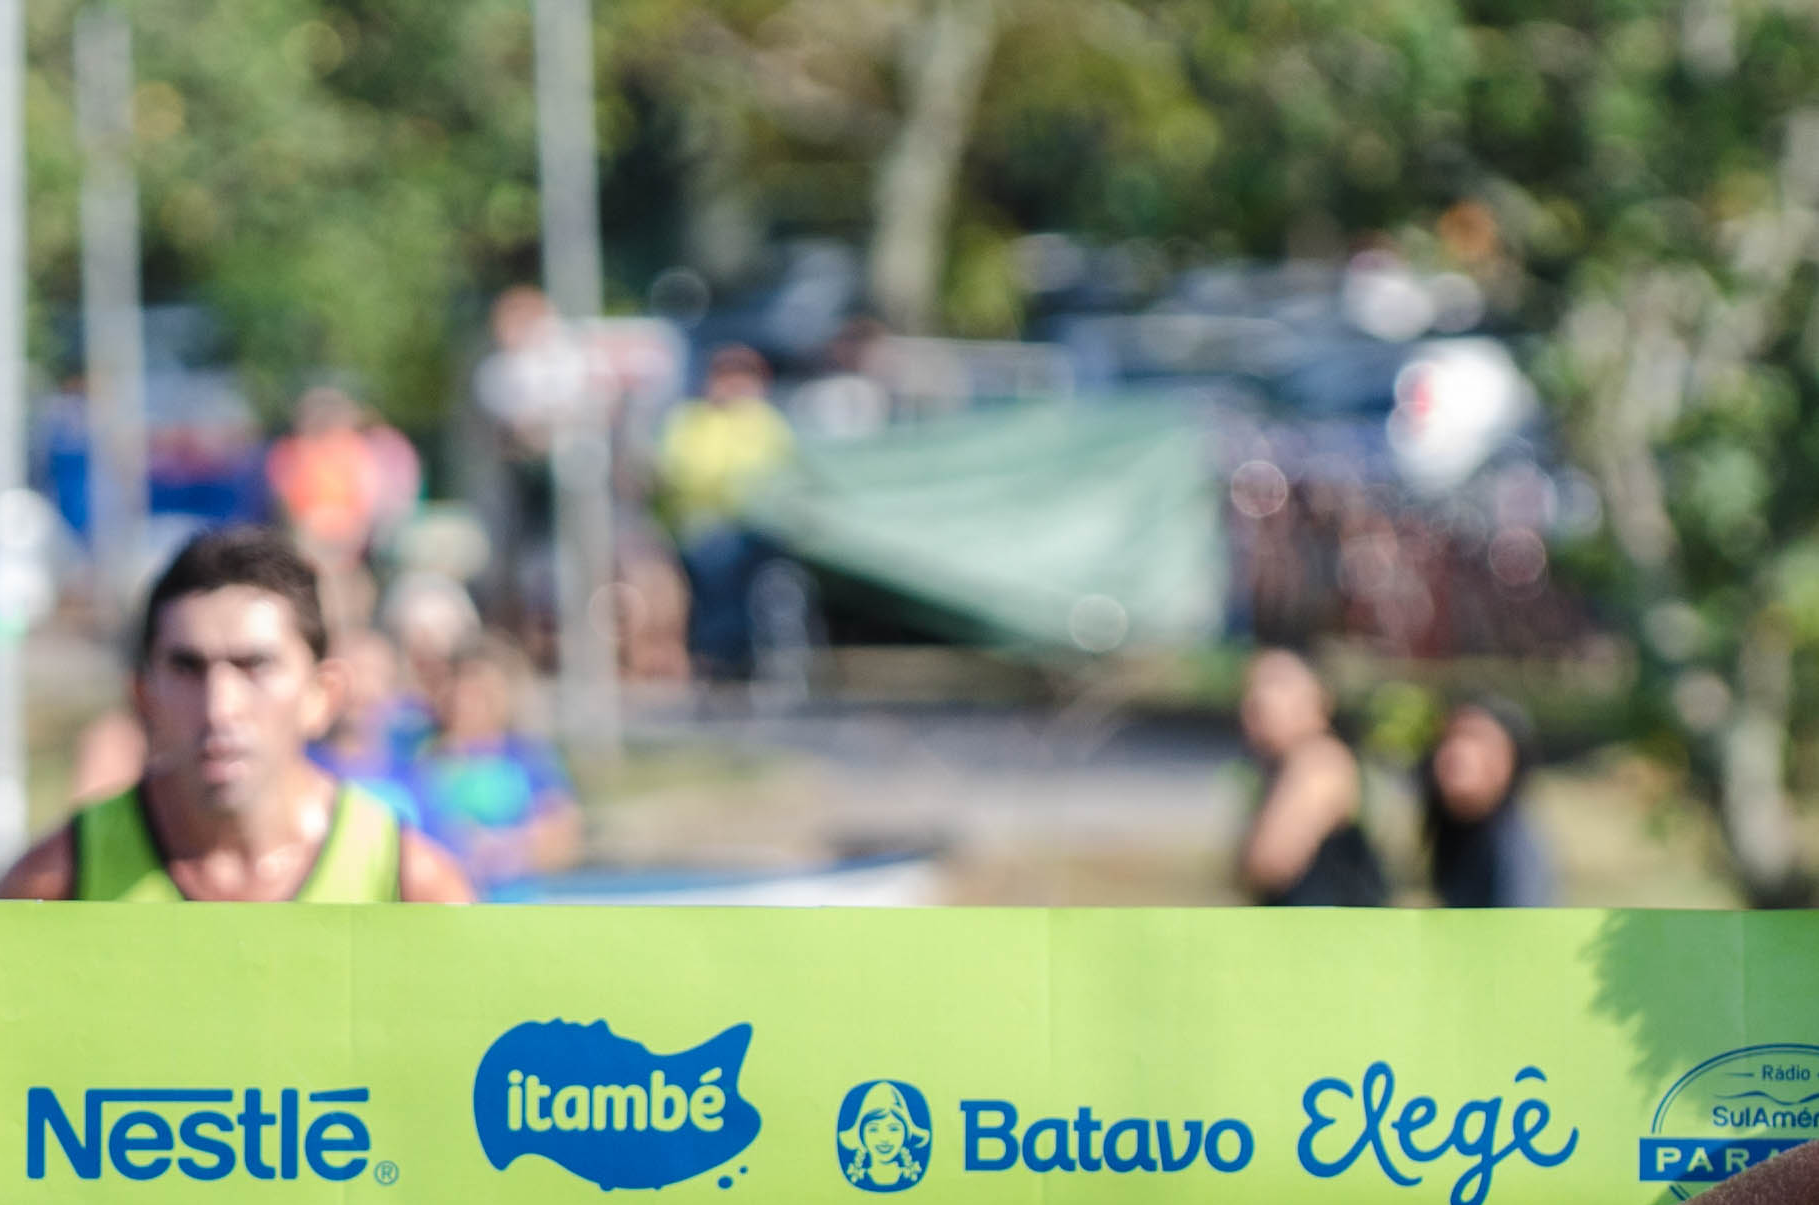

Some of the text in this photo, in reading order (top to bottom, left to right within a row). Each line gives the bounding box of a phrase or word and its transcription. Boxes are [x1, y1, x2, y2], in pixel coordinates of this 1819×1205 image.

[506, 1066, 726, 1133] itambé
[1761, 1065, 1811, 1081] Rádio
[959, 1099, 1255, 1174] Batavo
